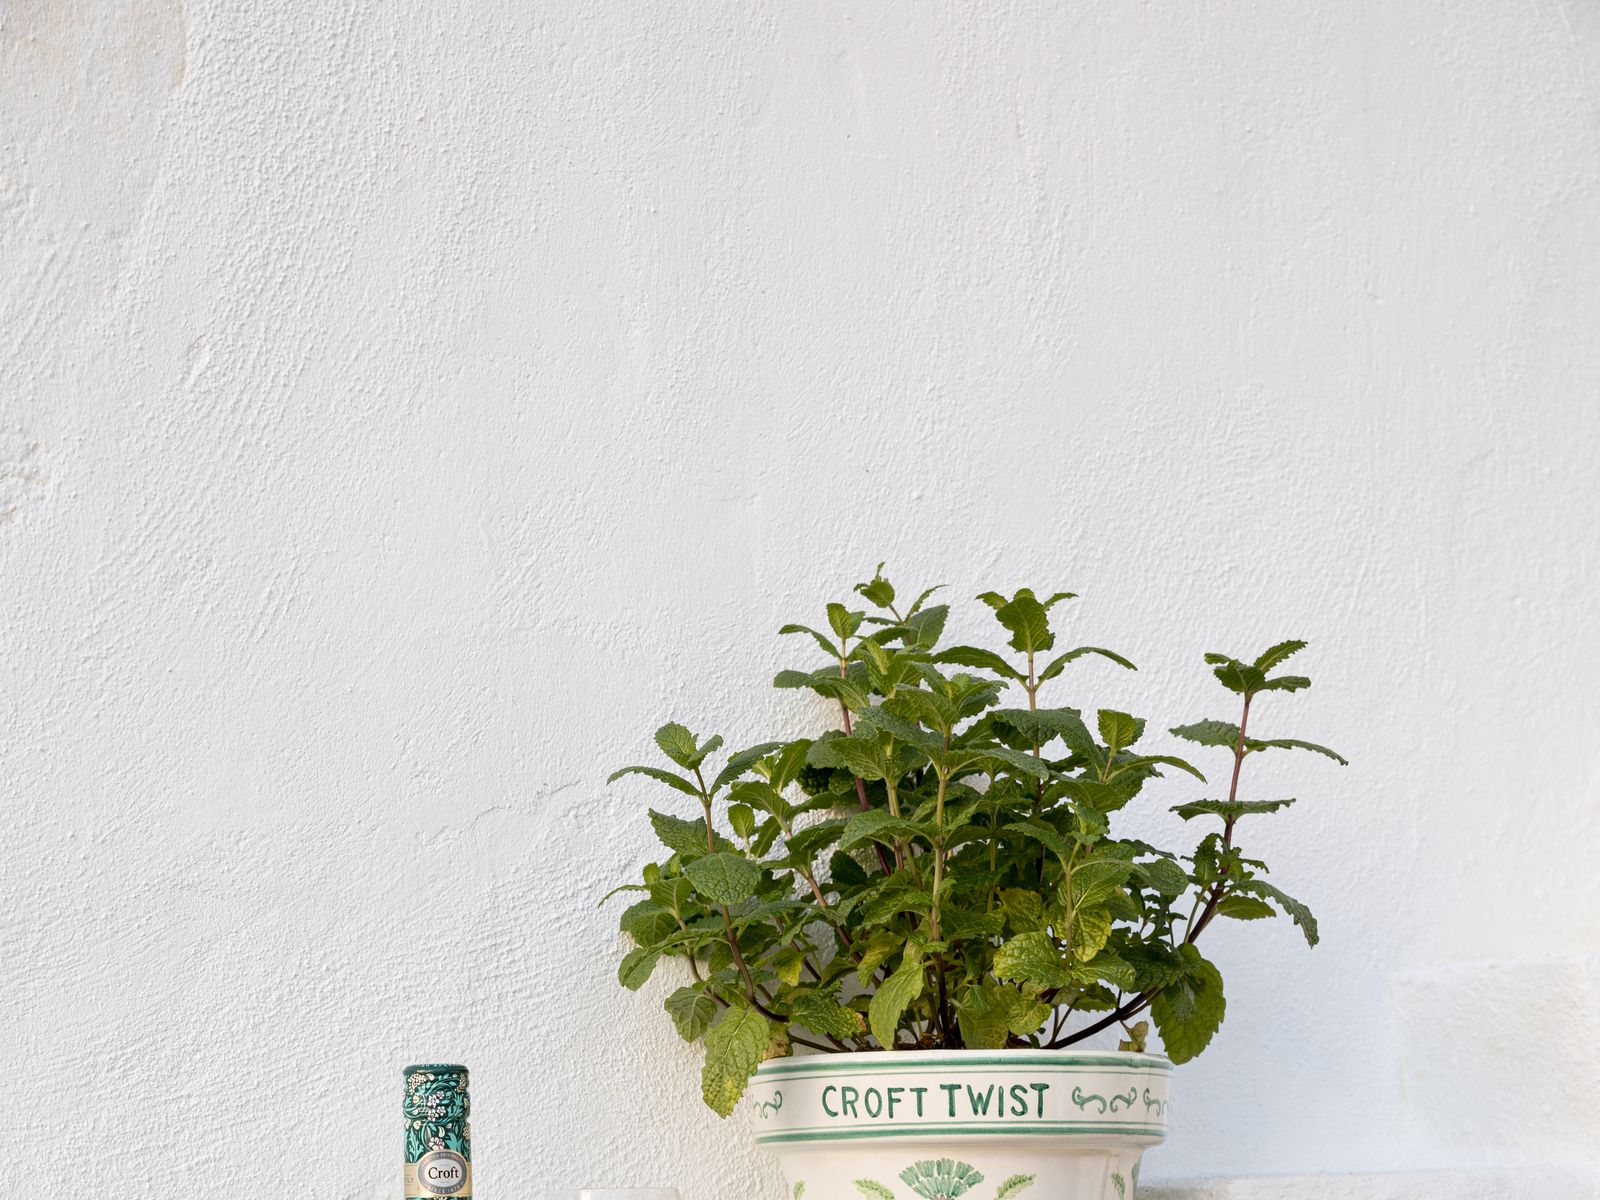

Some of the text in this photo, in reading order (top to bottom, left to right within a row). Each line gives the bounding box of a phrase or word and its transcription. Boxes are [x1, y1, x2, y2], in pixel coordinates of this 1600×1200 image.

[822, 1083, 1050, 1119] CROFT TWIST
[428, 1166, 460, 1180] Croft
